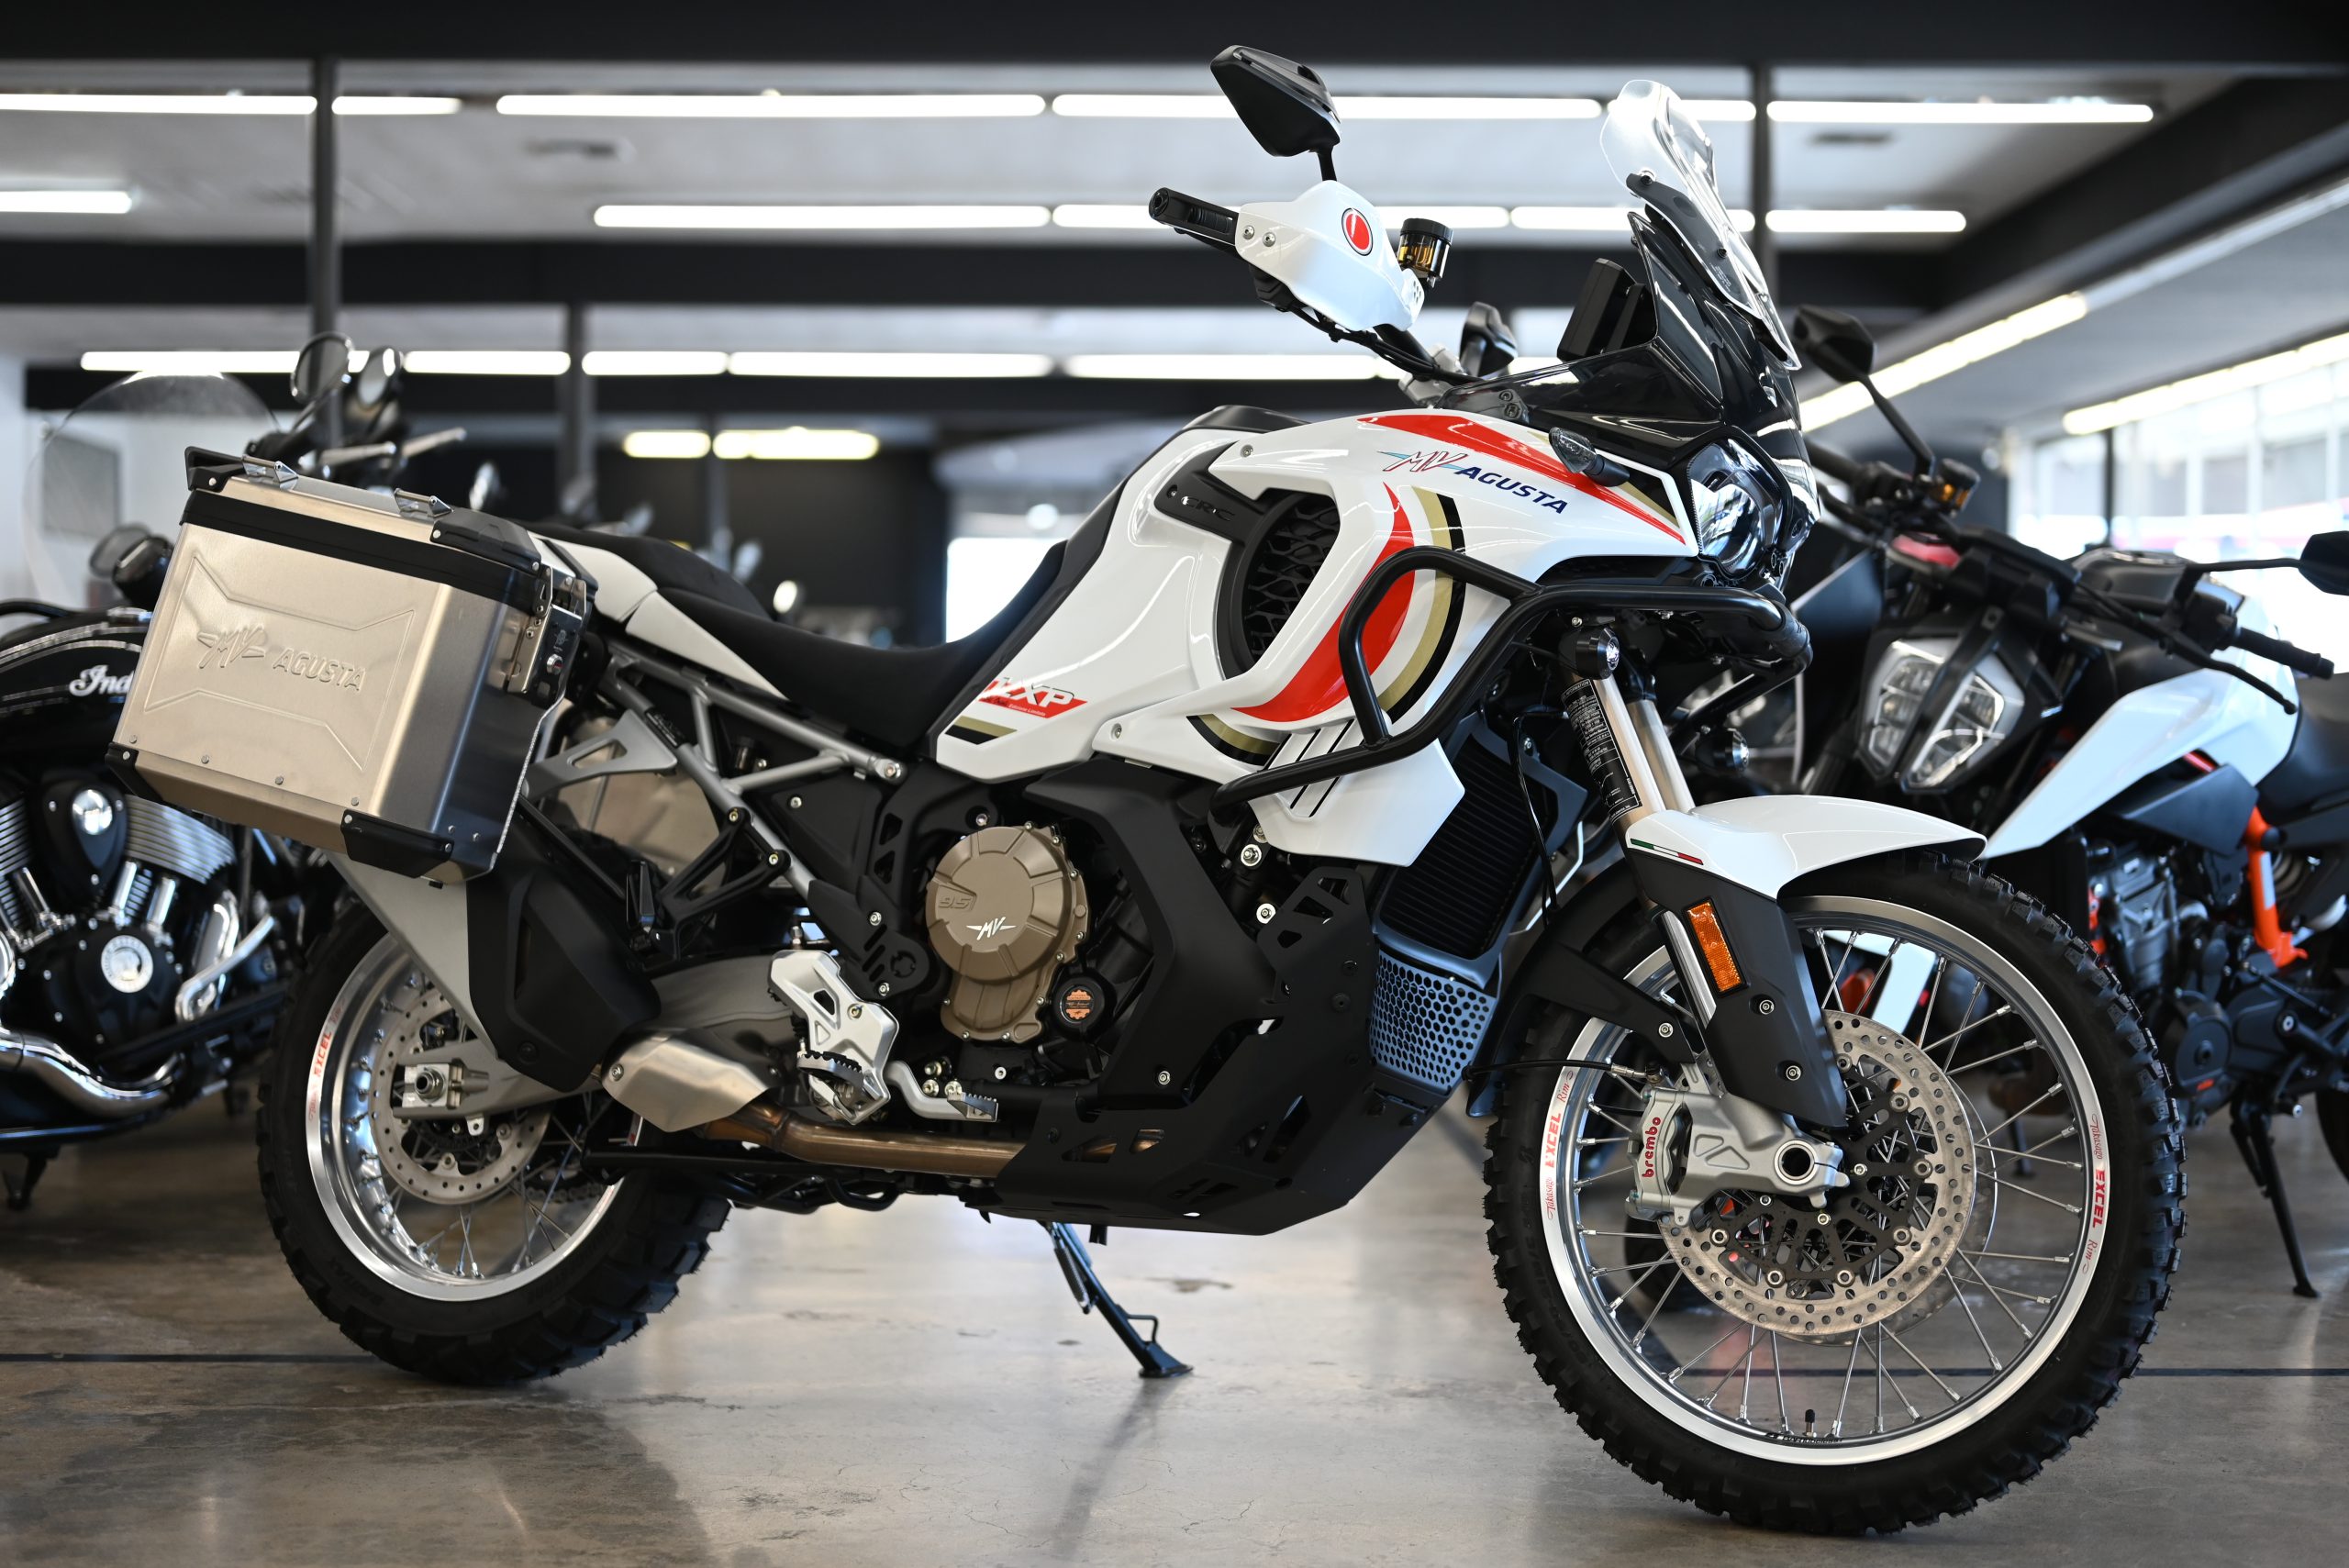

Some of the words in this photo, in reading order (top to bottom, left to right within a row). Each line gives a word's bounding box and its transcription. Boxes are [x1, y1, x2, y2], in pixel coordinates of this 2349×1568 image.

[1378, 450, 1468, 473] MV
[1453, 466, 1568, 514] AGUSTA
[273, 647, 367, 692] AGUSTA
[974, 916, 1008, 940] MV
[314, 1030, 332, 1077] EXCEL
[1556, 1076, 1572, 1103] Rim
[1544, 1113, 1562, 1168] EXCEL
[1642, 1117, 1662, 1178] brembo
[2089, 1114, 2103, 1160] Takasago
[2092, 1169, 2105, 1229] EXCEL
[2084, 1240, 2099, 1267] Rim
